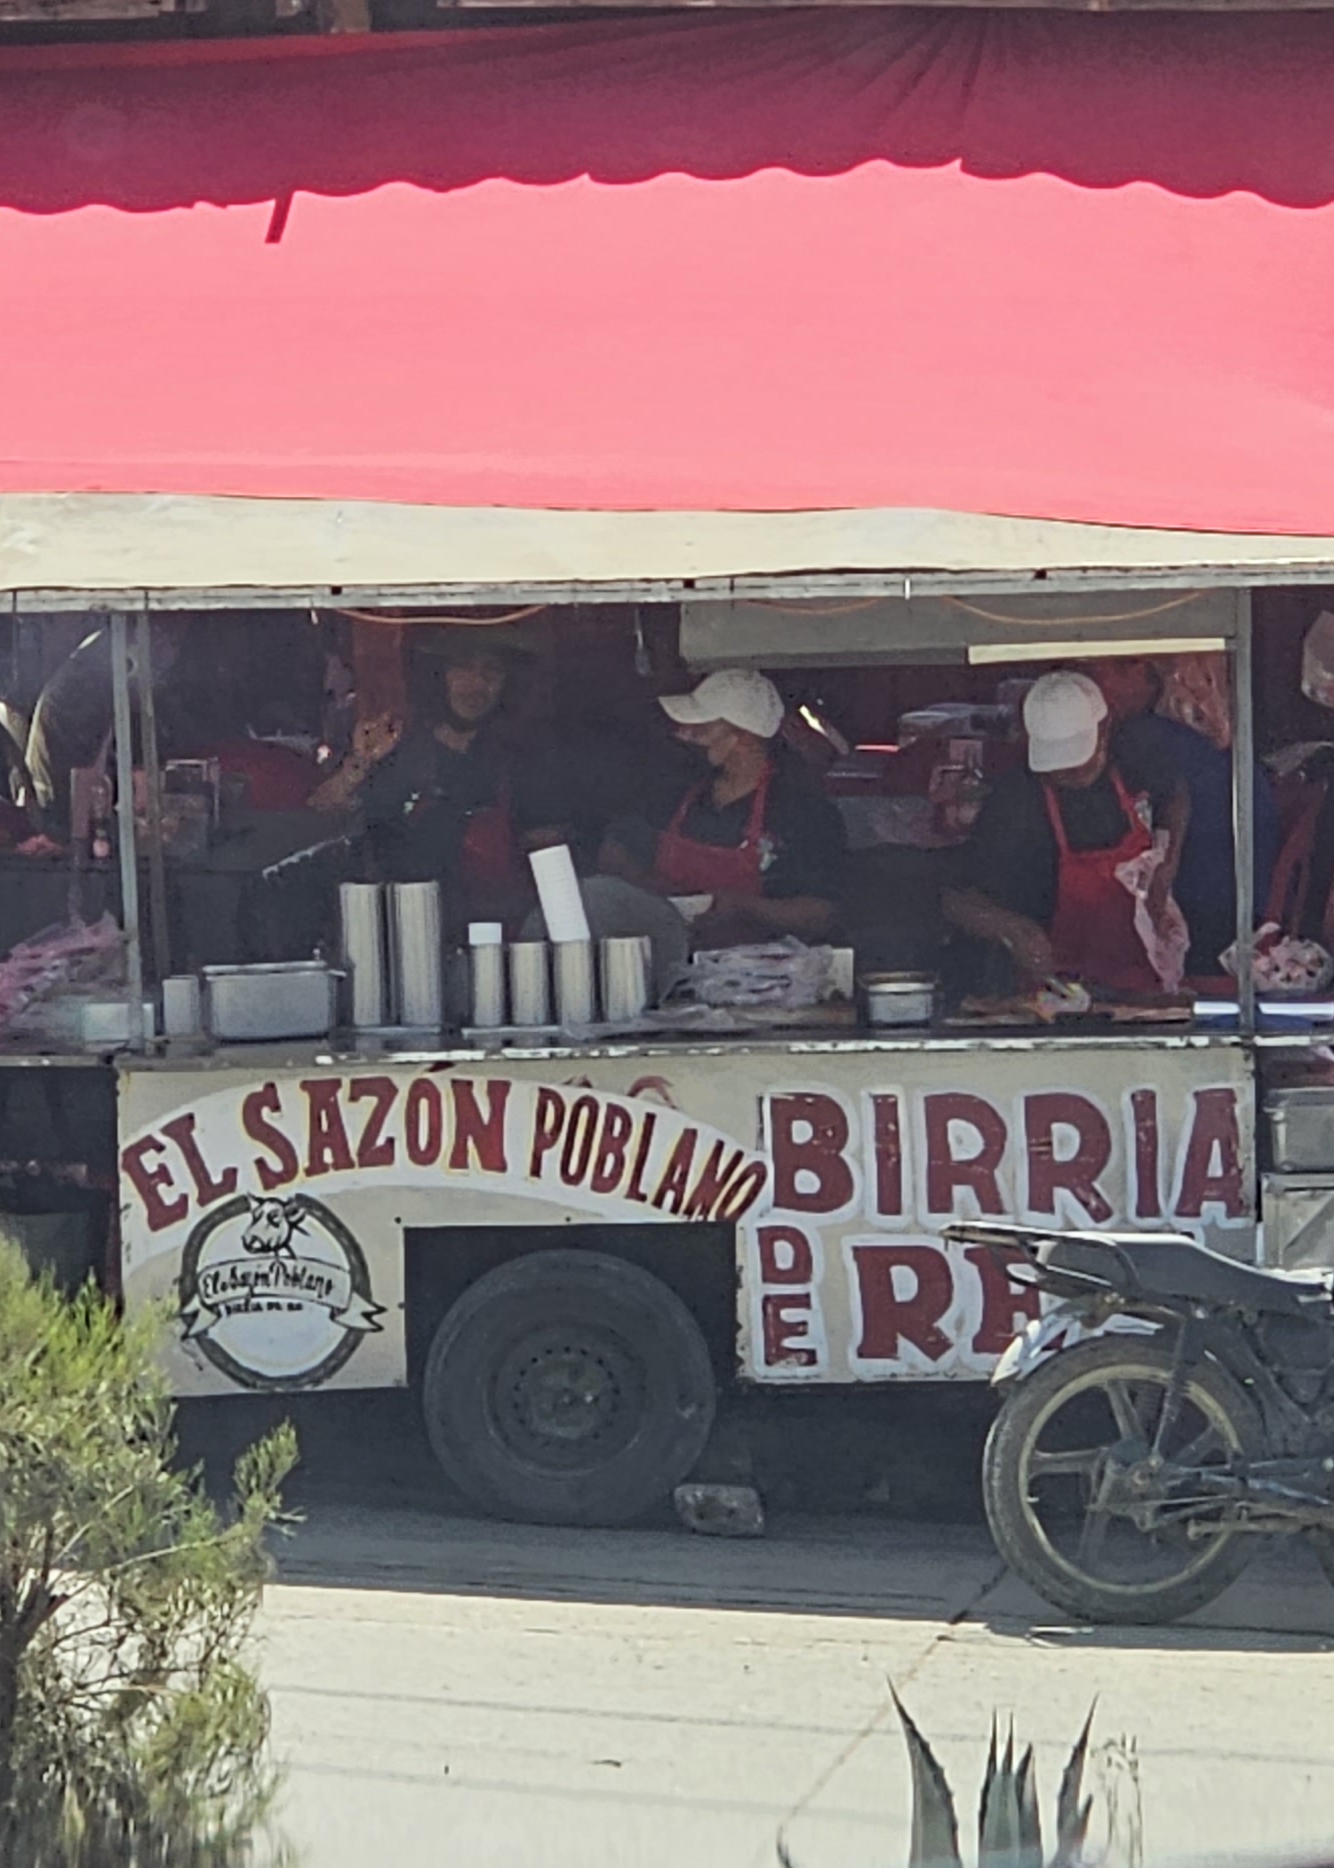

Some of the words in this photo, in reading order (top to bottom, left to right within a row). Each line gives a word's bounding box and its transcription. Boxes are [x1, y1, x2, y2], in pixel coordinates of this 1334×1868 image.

[122, 1113, 237, 1232] EL
[242, 1061, 511, 1192] SAZÓN
[529, 1087, 767, 1222] POBLANO
[770, 1088, 1251, 1223] BIRRIA
[757, 1226, 817, 1366] DE
[851, 1238, 1067, 1362] RE
